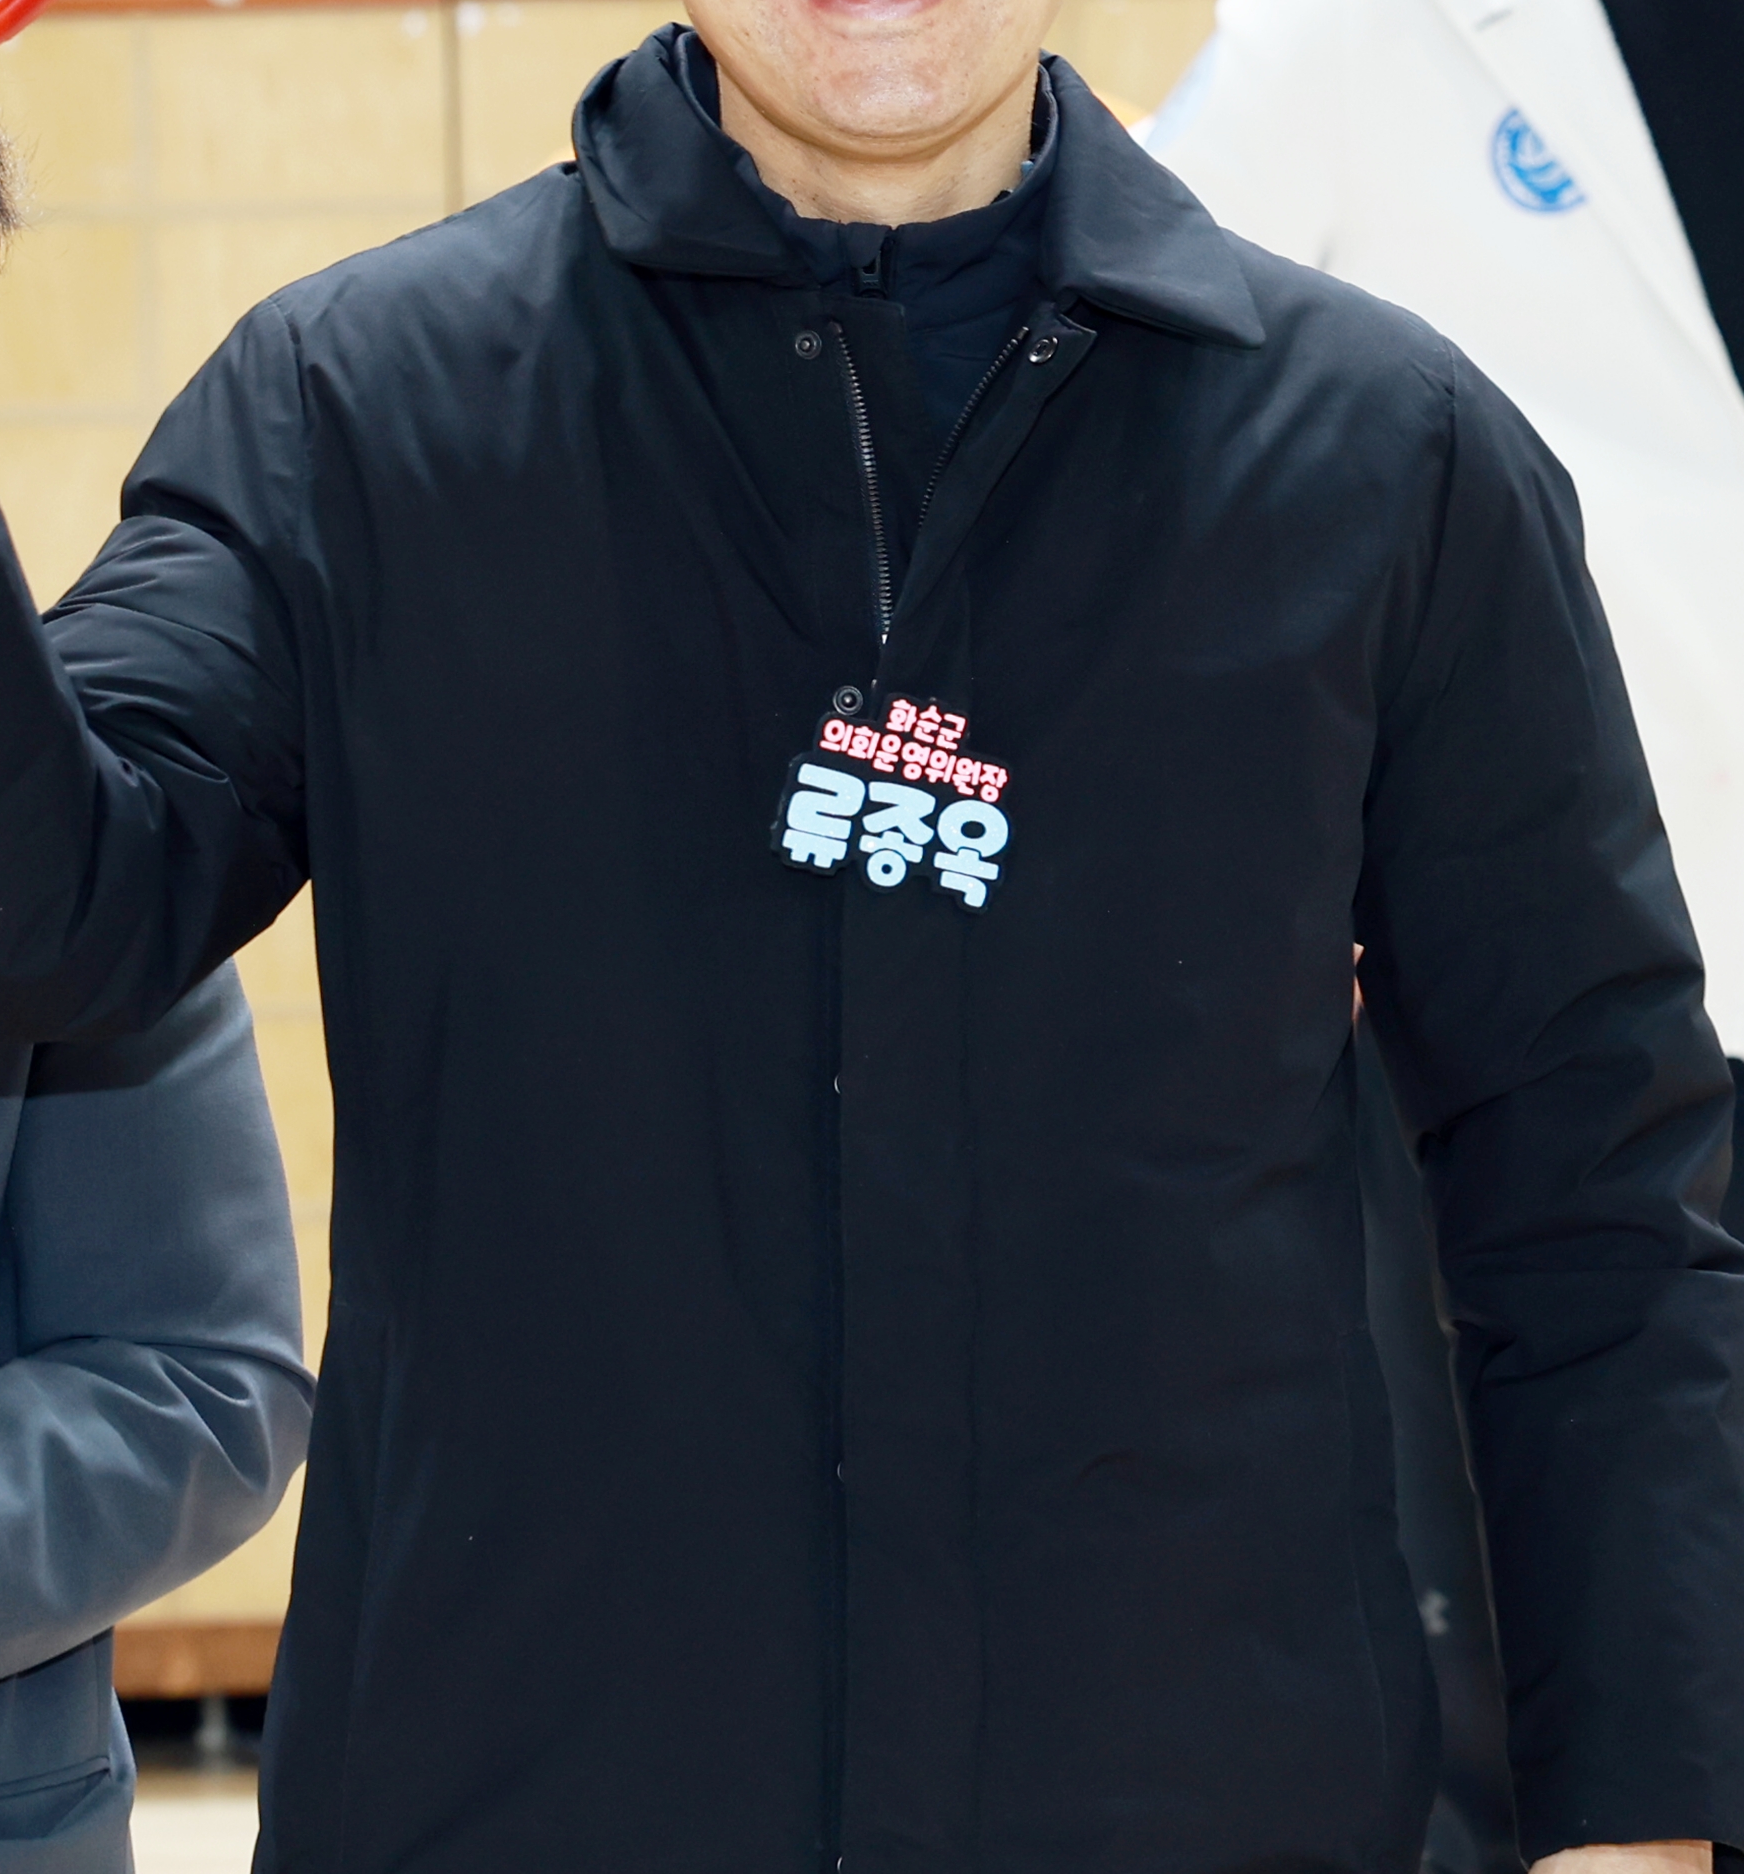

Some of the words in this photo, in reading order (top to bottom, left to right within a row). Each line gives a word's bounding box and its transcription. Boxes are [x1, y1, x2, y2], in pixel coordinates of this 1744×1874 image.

[819, 719, 1008, 803] 의회운영위원장
[886, 699, 966, 750] 화순군
[781, 763, 1009, 908] 류종욱
